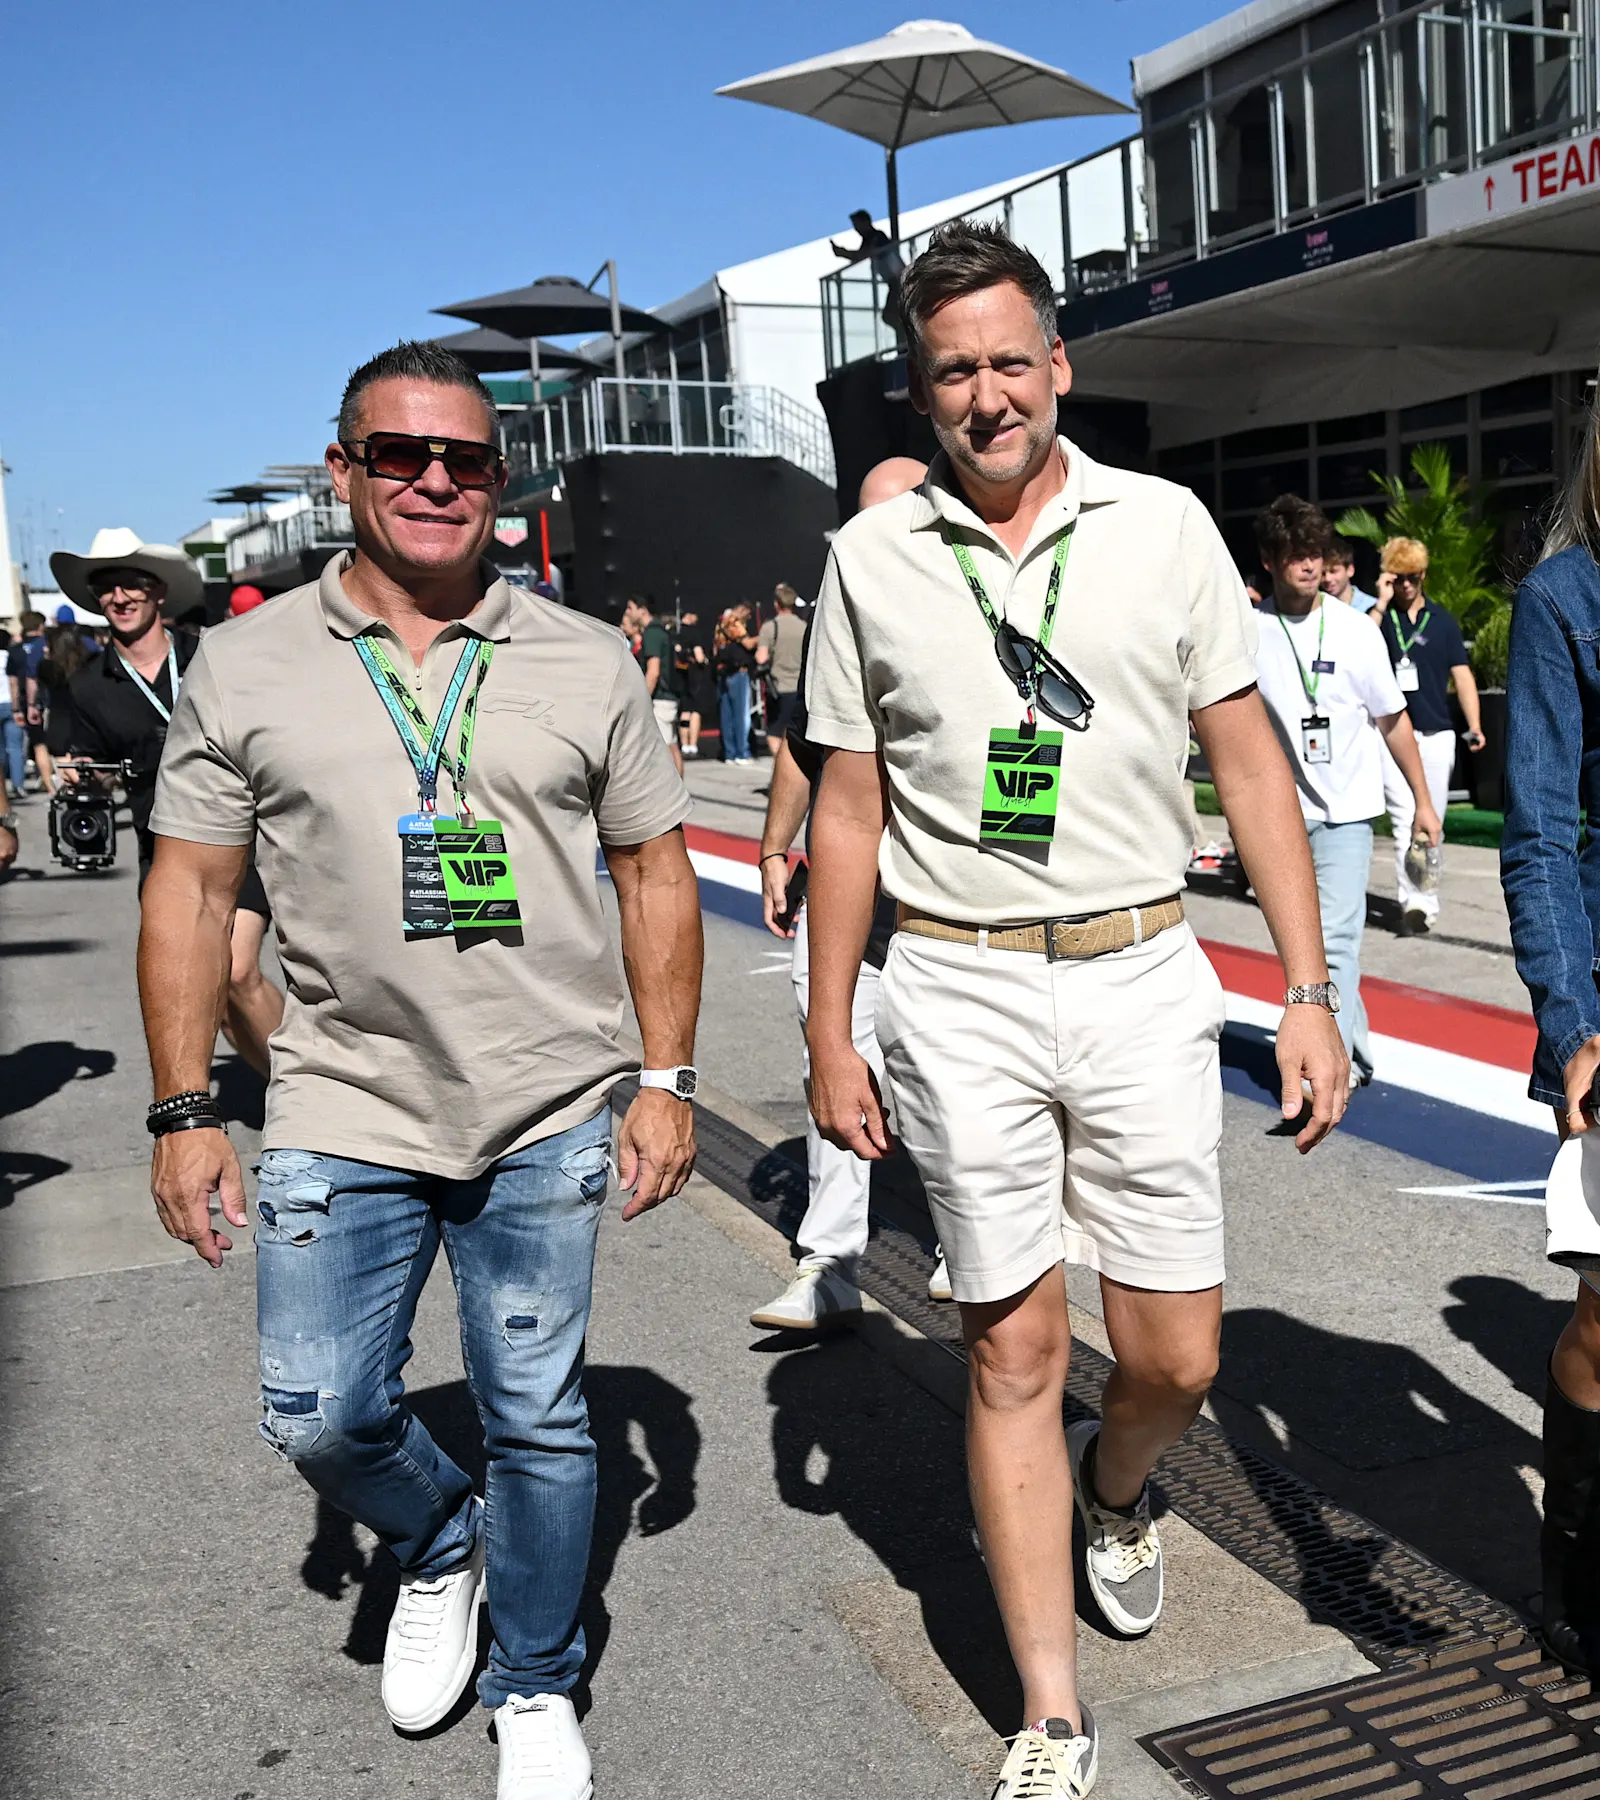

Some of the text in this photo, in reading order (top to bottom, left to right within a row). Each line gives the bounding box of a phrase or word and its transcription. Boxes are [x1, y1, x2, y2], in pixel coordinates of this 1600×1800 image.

[365, 655, 381, 679] SUNDAY
[458, 653, 472, 677] SUNDAY
[993, 769, 1054, 799] VIP
[447, 860, 507, 887] VIP
